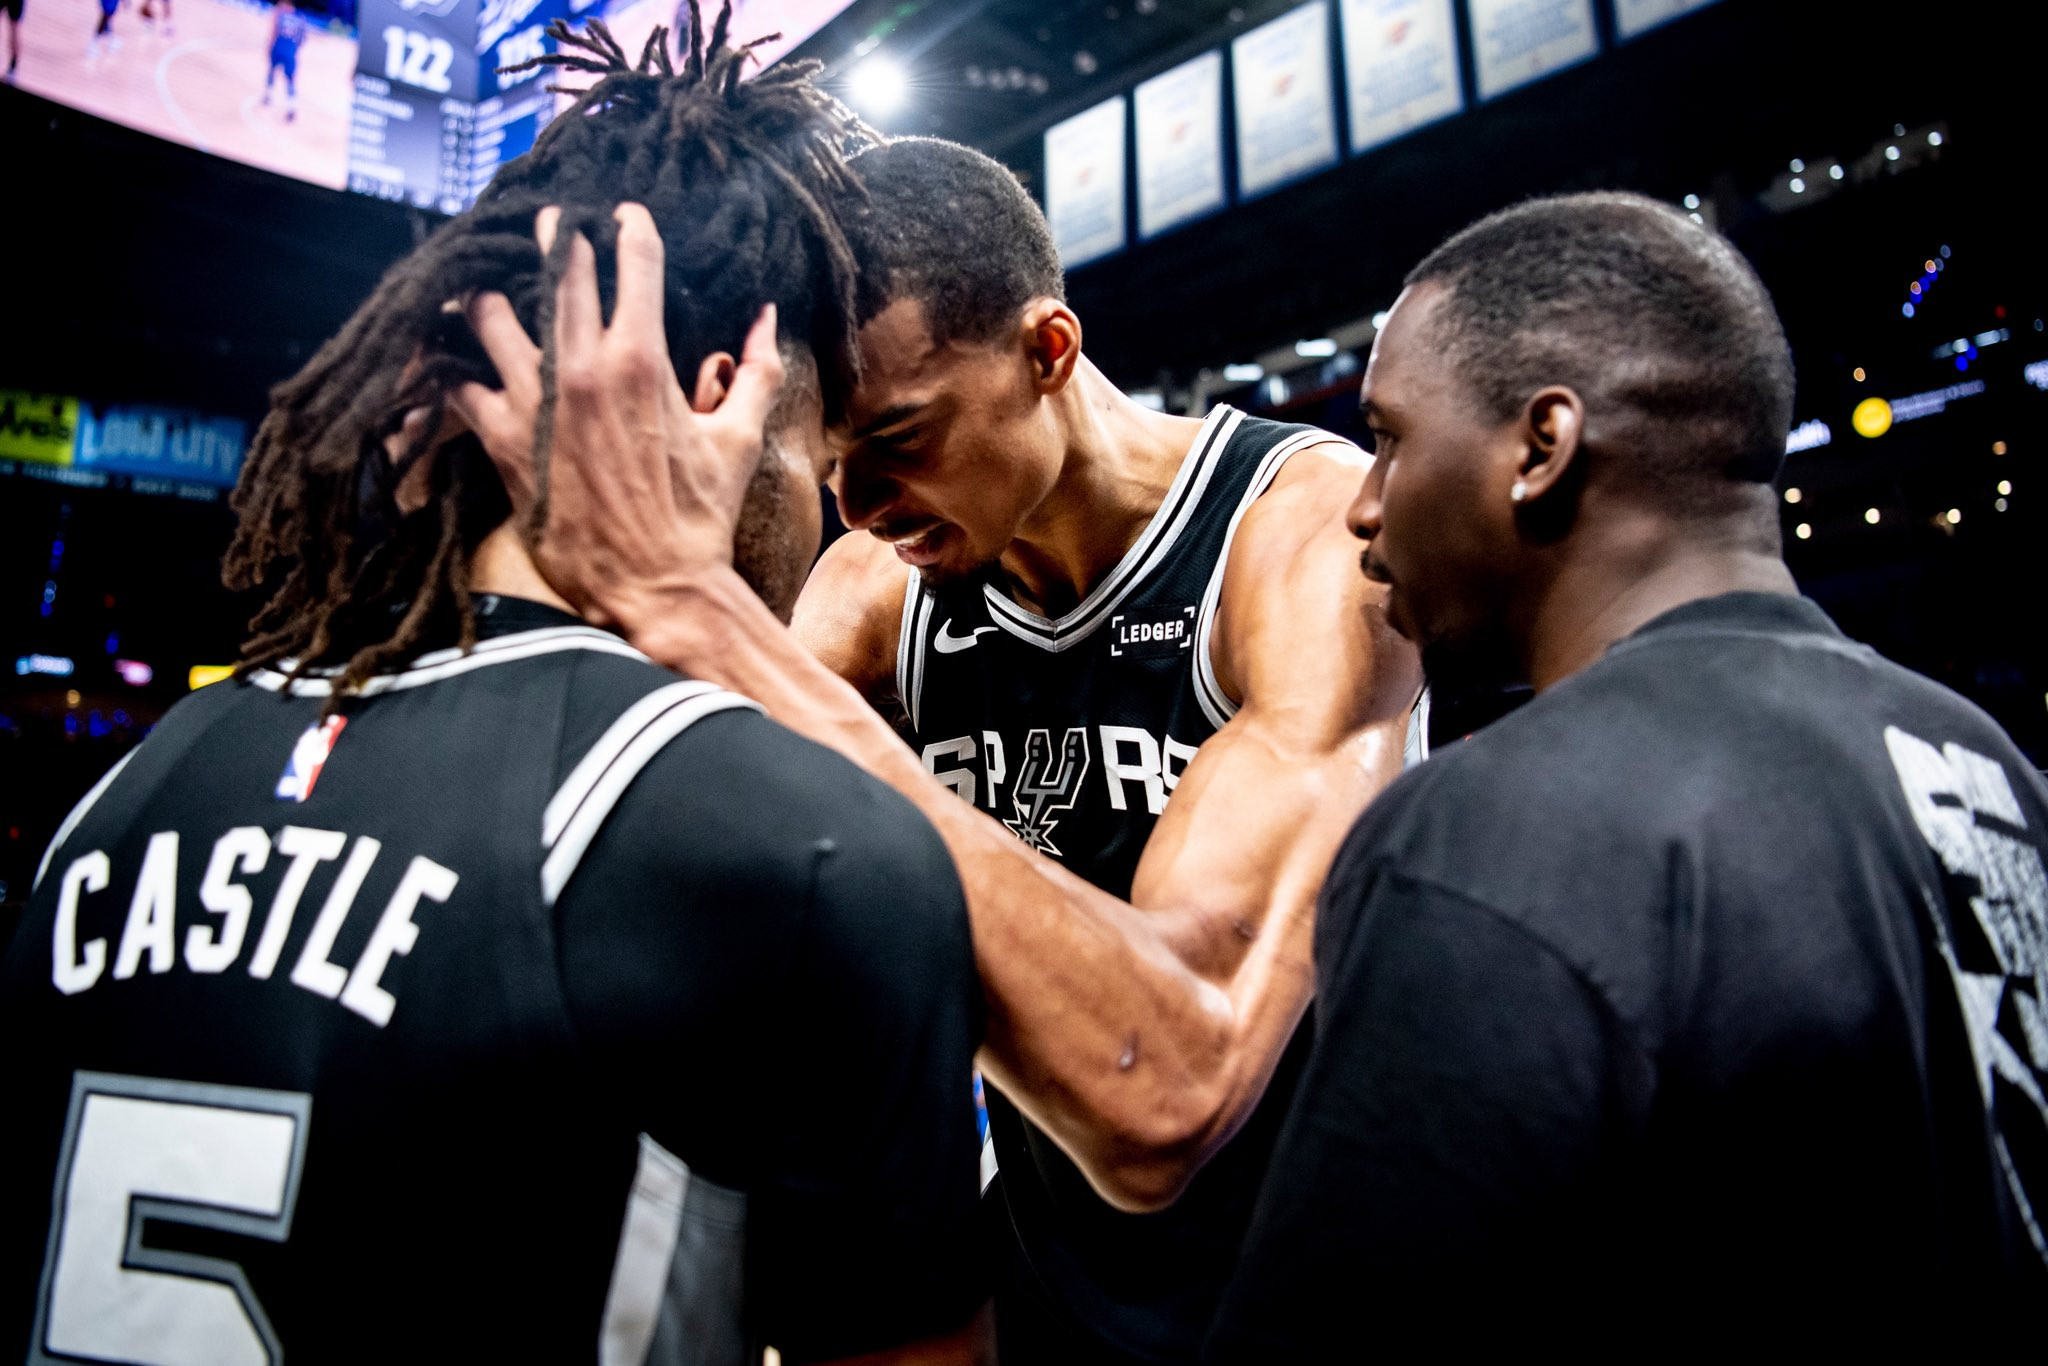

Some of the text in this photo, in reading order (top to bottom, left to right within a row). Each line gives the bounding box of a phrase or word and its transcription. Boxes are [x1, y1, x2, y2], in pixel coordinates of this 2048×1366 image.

[383, 26, 453, 92] 122
[1121, 620, 1184, 643] LEDGER
[52, 826, 458, 1027] CASTLE
[26, 1069, 312, 1366] 5
